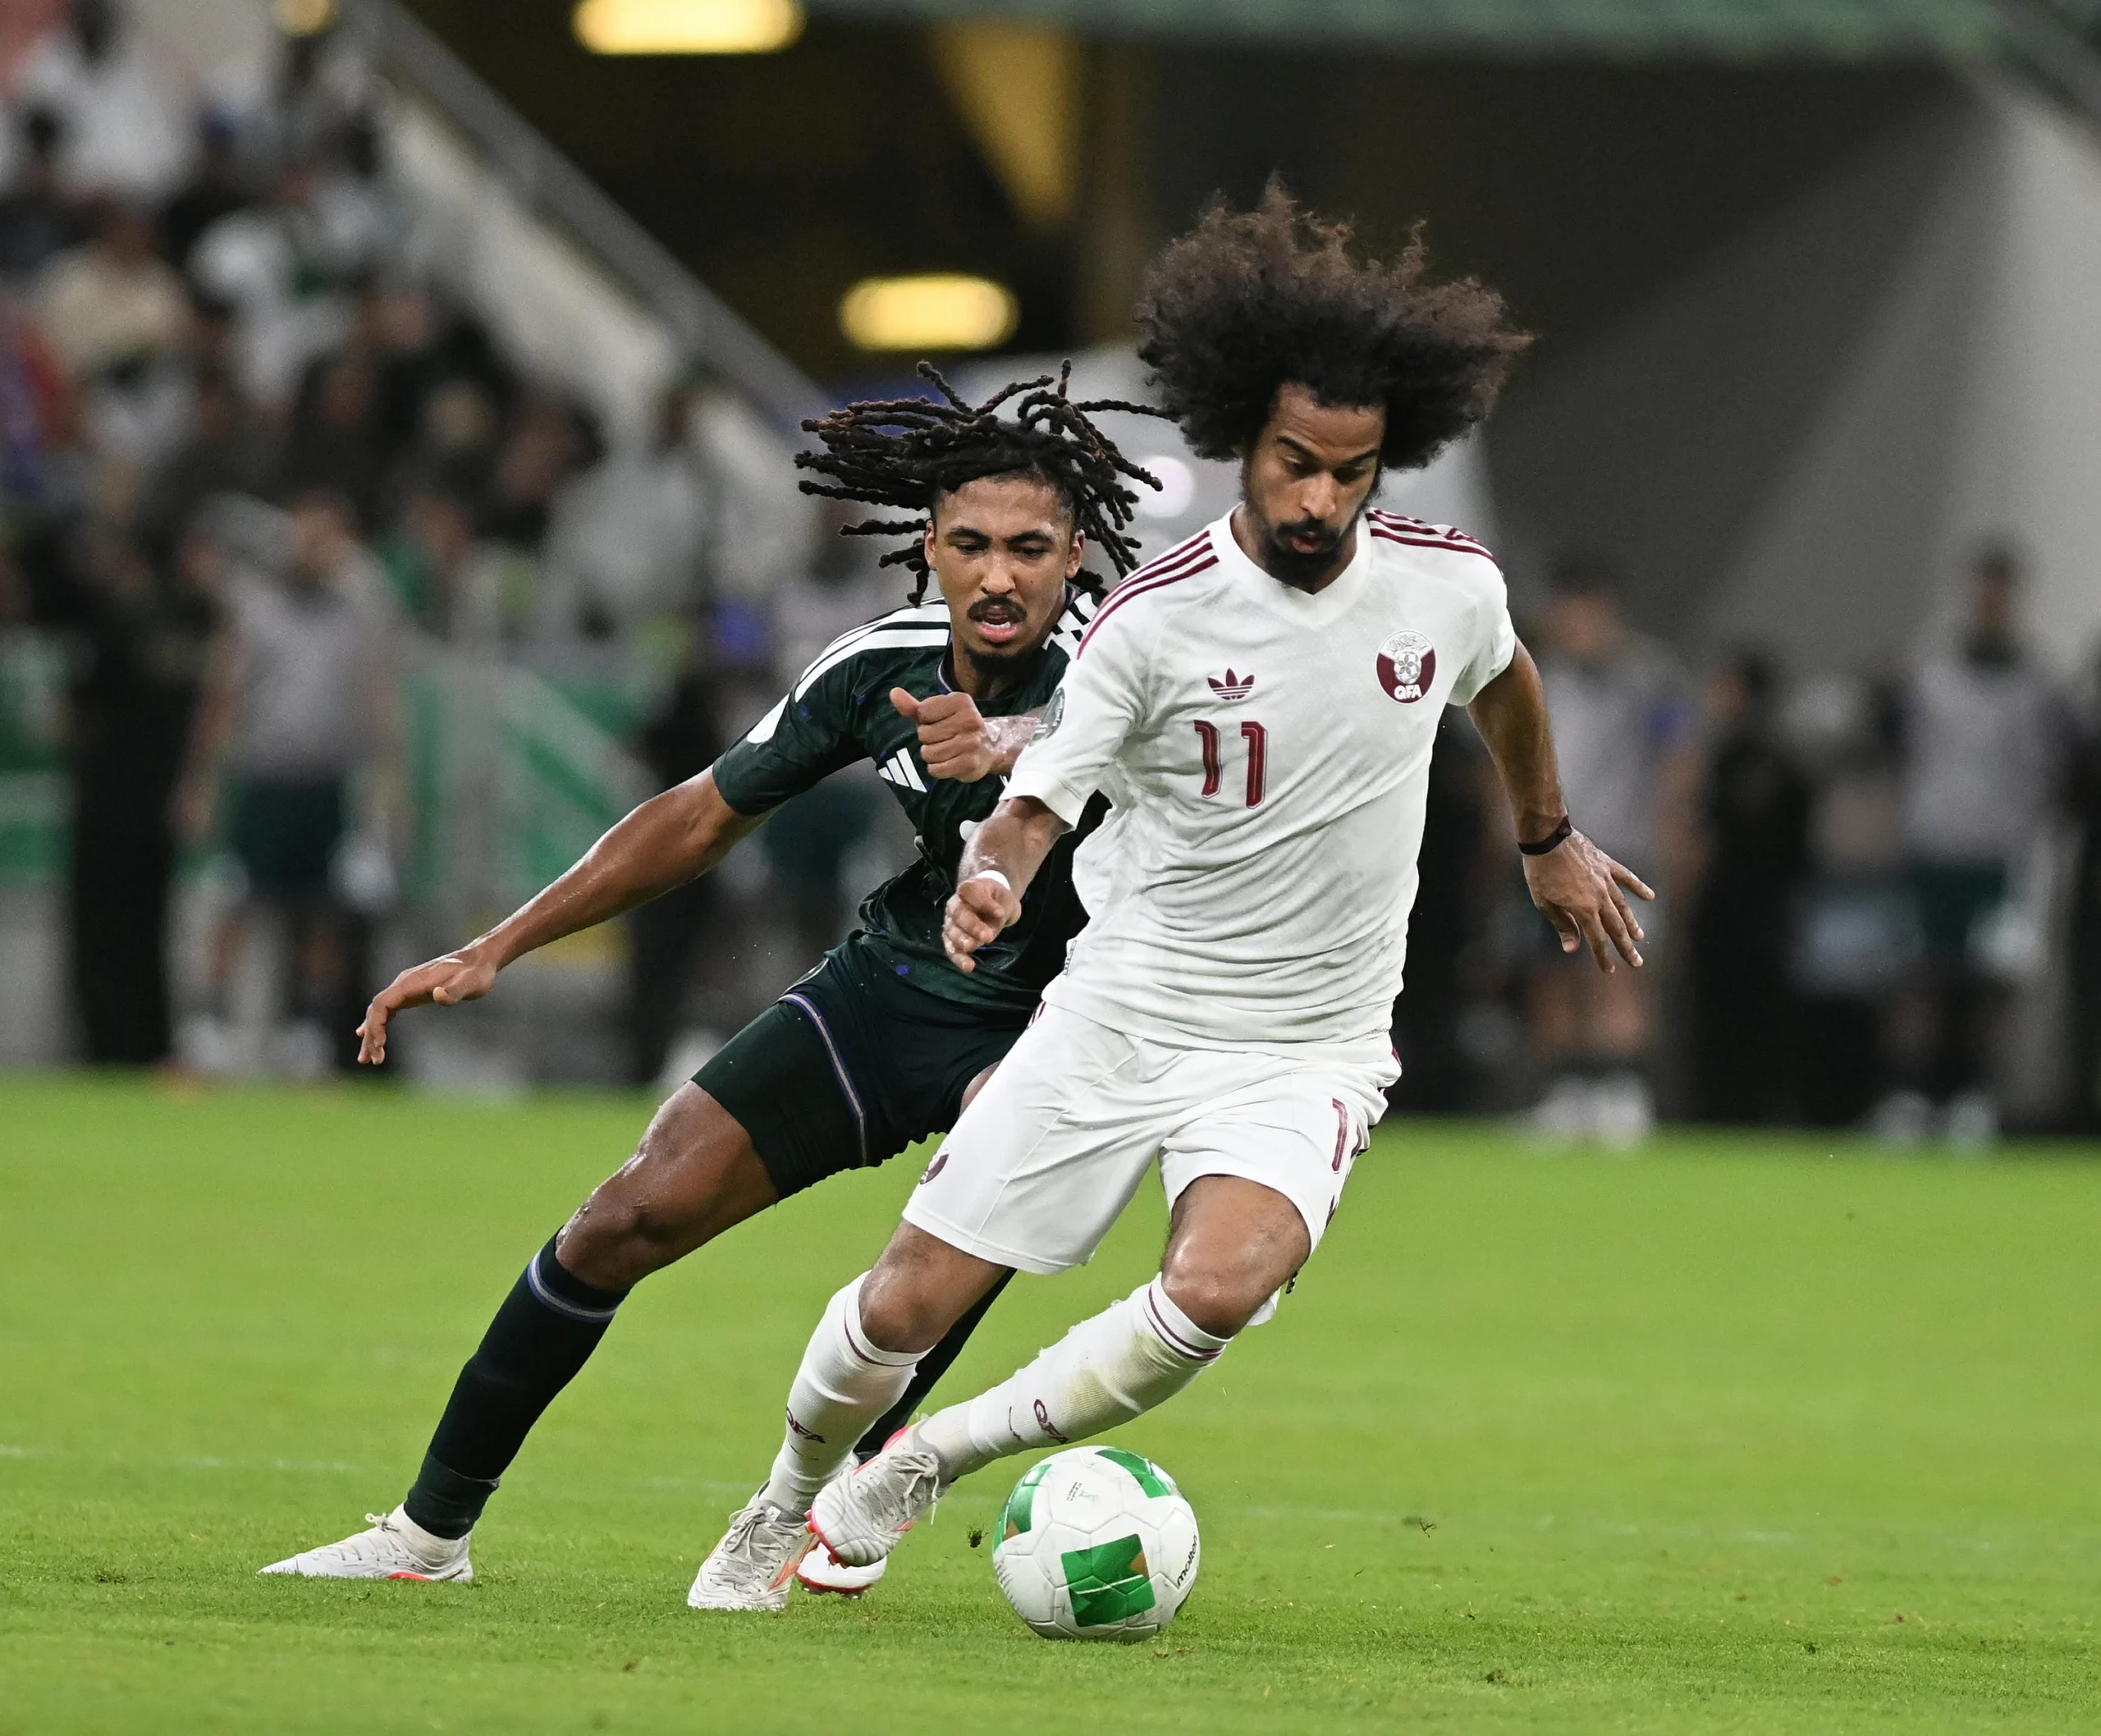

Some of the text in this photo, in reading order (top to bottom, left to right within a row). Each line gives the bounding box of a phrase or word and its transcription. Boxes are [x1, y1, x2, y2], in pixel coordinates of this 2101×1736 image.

[1394, 684, 1422, 700] QFA
[1193, 719, 1269, 809] 11
[1177, 1534, 1198, 1587] molten
